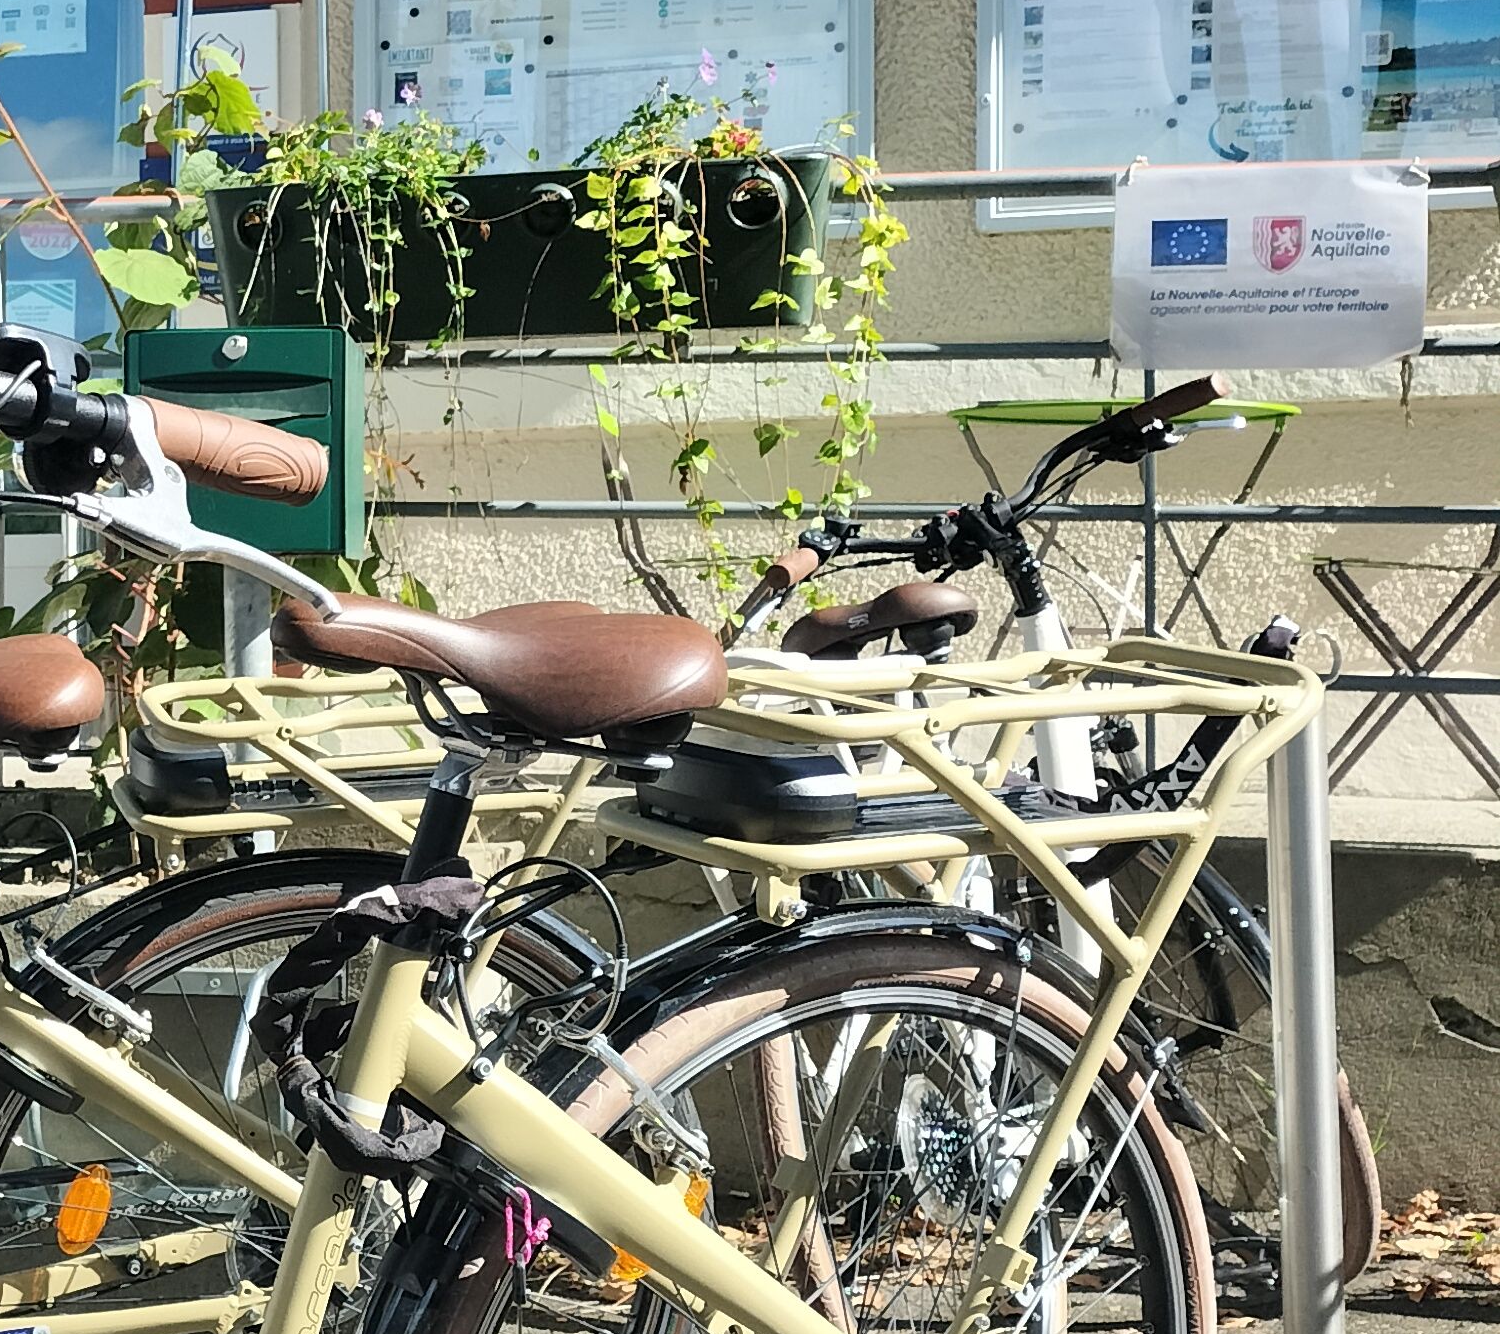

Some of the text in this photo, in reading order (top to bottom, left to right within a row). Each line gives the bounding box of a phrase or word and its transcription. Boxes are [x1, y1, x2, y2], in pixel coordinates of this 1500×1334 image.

[1311, 227, 1392, 243] Nouvelle-
[1311, 243, 1391, 261] Aquitaine
[1150, 287, 1360, 301] La Nouvelle-Aquitaine et l'Europe
[1204, 302, 1267, 314] ensemble
[1269, 303, 1298, 316] pour
[1303, 302, 1333, 313] votre
[1337, 301, 1390, 313] territoire
